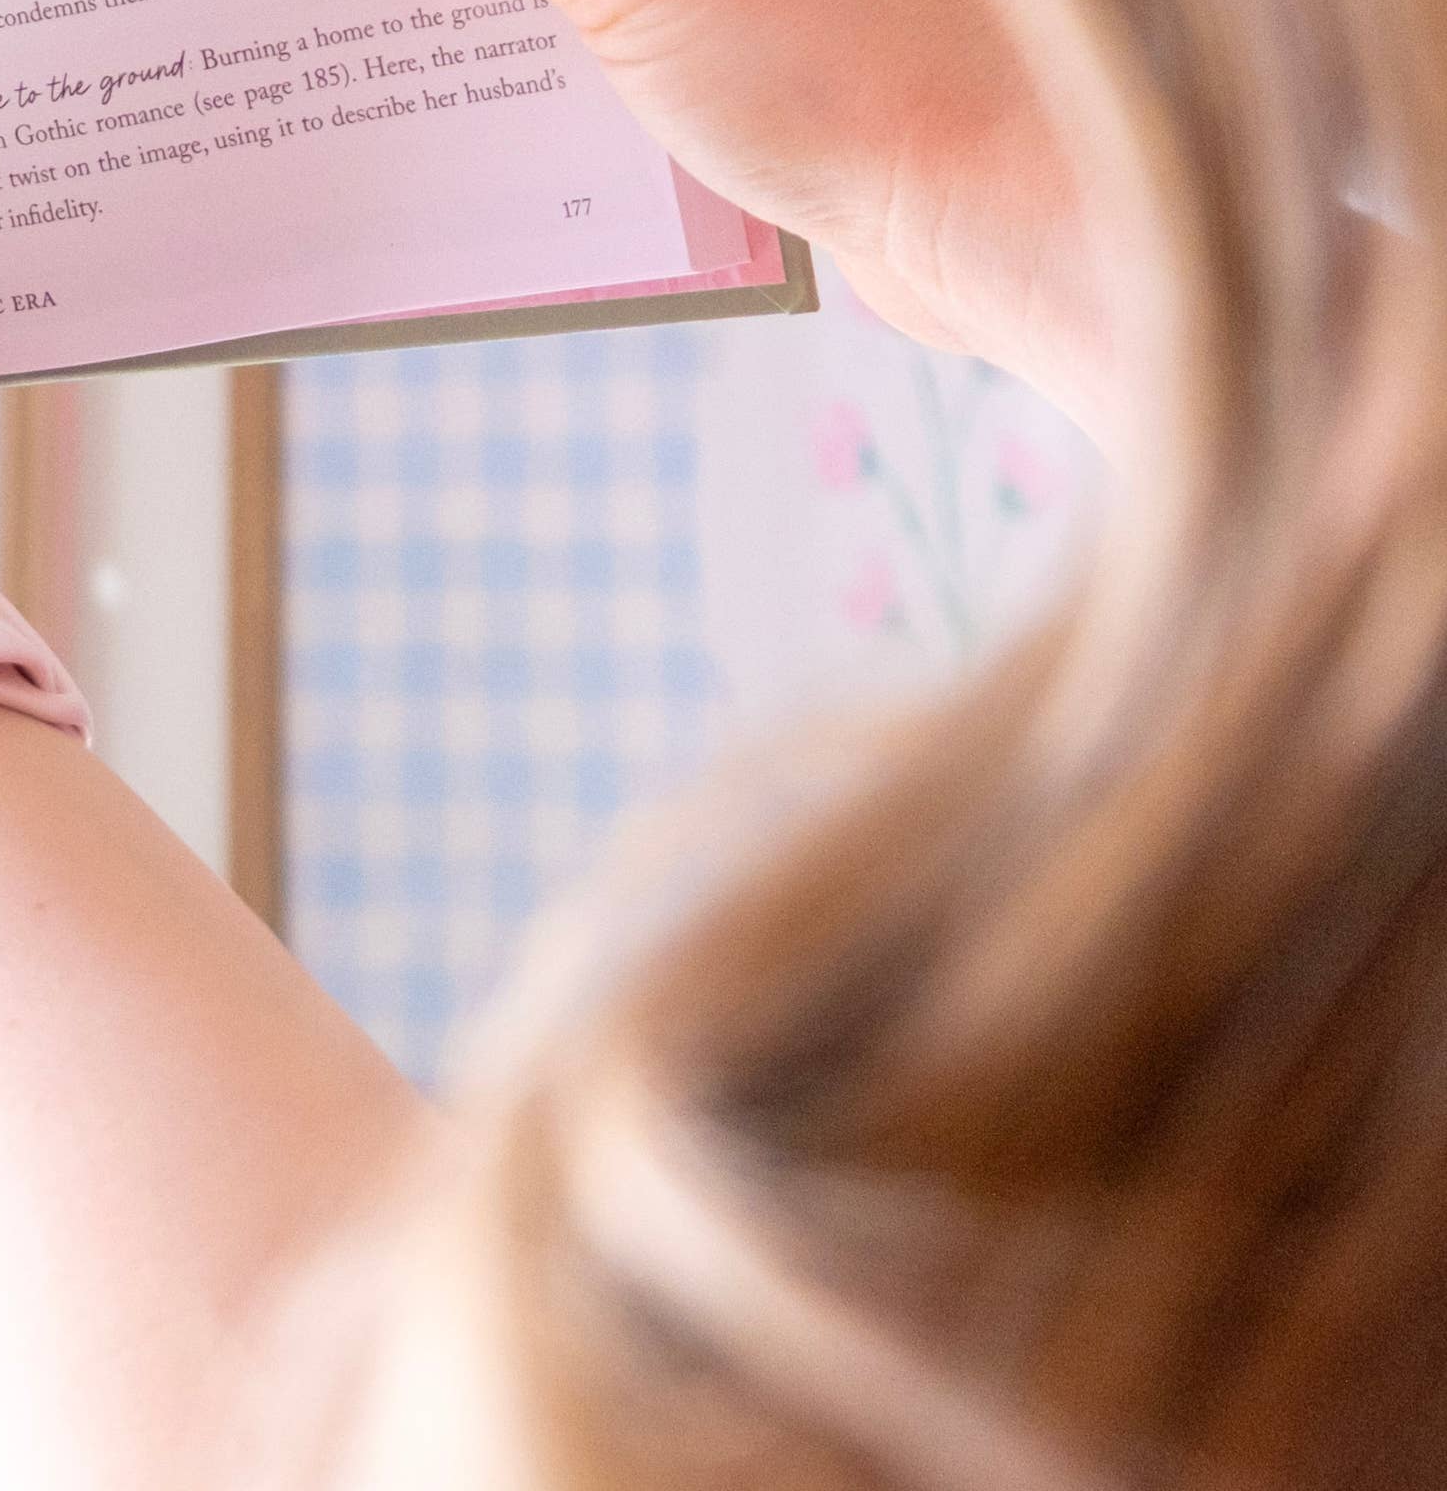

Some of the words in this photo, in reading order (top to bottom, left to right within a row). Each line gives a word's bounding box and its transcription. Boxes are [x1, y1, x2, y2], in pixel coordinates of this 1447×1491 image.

[14, 82, 42, 108] to
[46, 73, 92, 102] the
[200, 41, 291, 70] Burning
[296, 37, 309, 51] a
[313, 24, 374, 48] home
[381, 19, 403, 34] to
[410, 8, 444, 29] the
[562, 198, 591, 218] 177
[11, 291, 57, 312] ERA
